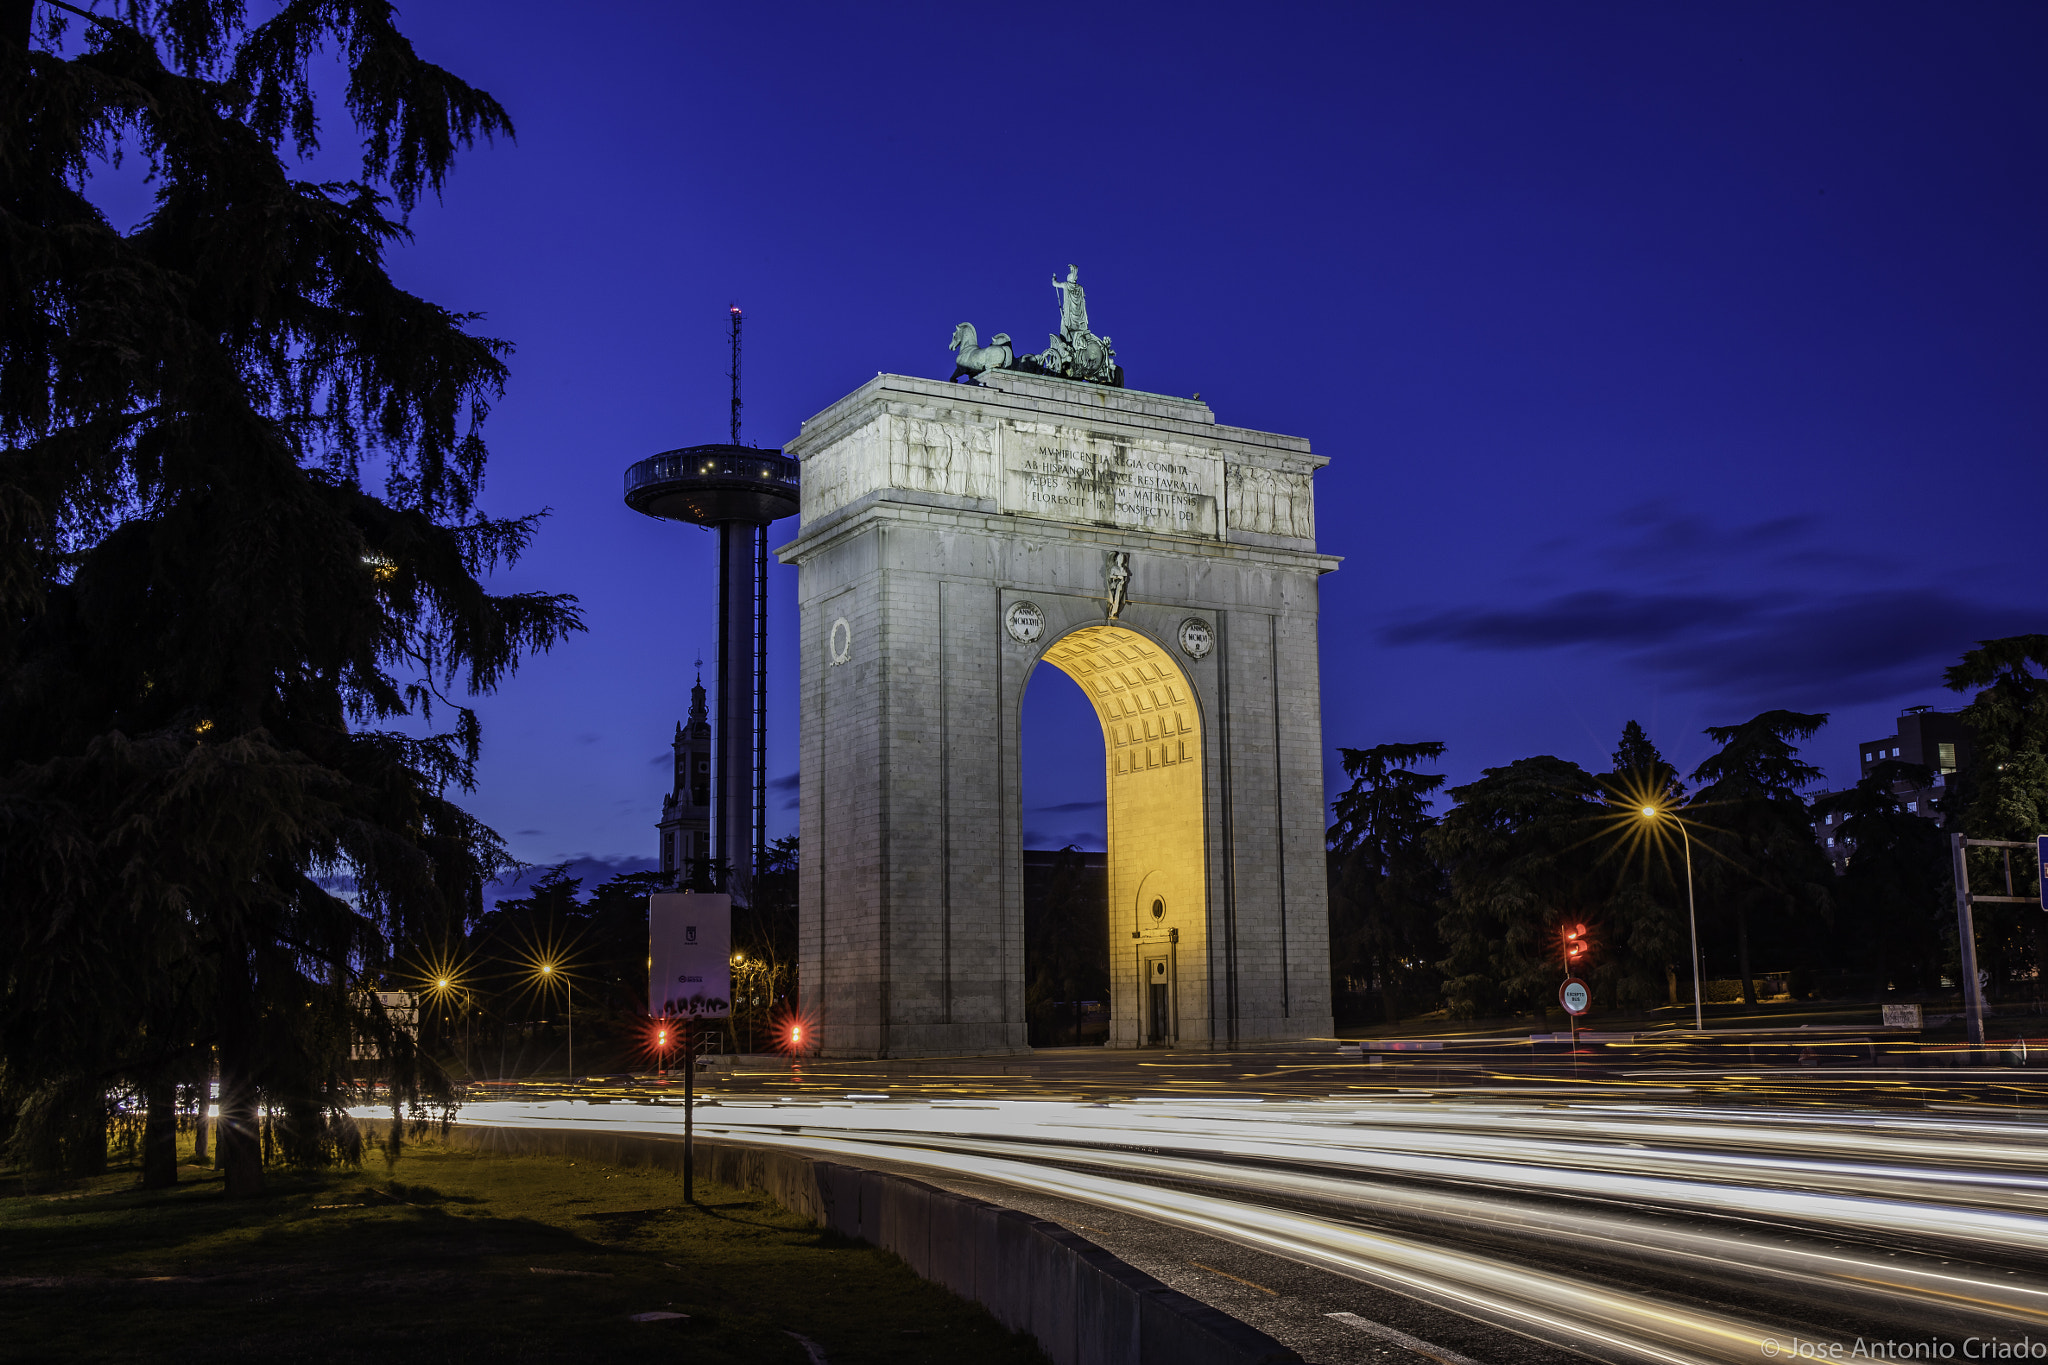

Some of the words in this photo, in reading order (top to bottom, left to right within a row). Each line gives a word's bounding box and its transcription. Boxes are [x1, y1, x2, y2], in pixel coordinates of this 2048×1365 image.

[1024, 460, 1038, 470] AB
[1042, 462, 1106, 483] HISPANORVM
[1138, 475, 1199, 492] RESTAVRATA
[1114, 456, 1142, 470] REGIA
[1147, 461, 1188, 478] CONDITA
[1032, 491, 1086, 508] FLORESCIT
[1096, 499, 1106, 510] IN
[1115, 503, 1170, 519] CONSPECTV
[1179, 511, 1194, 522] DEI
[1134, 489, 1197, 507] MATRITENSIS
